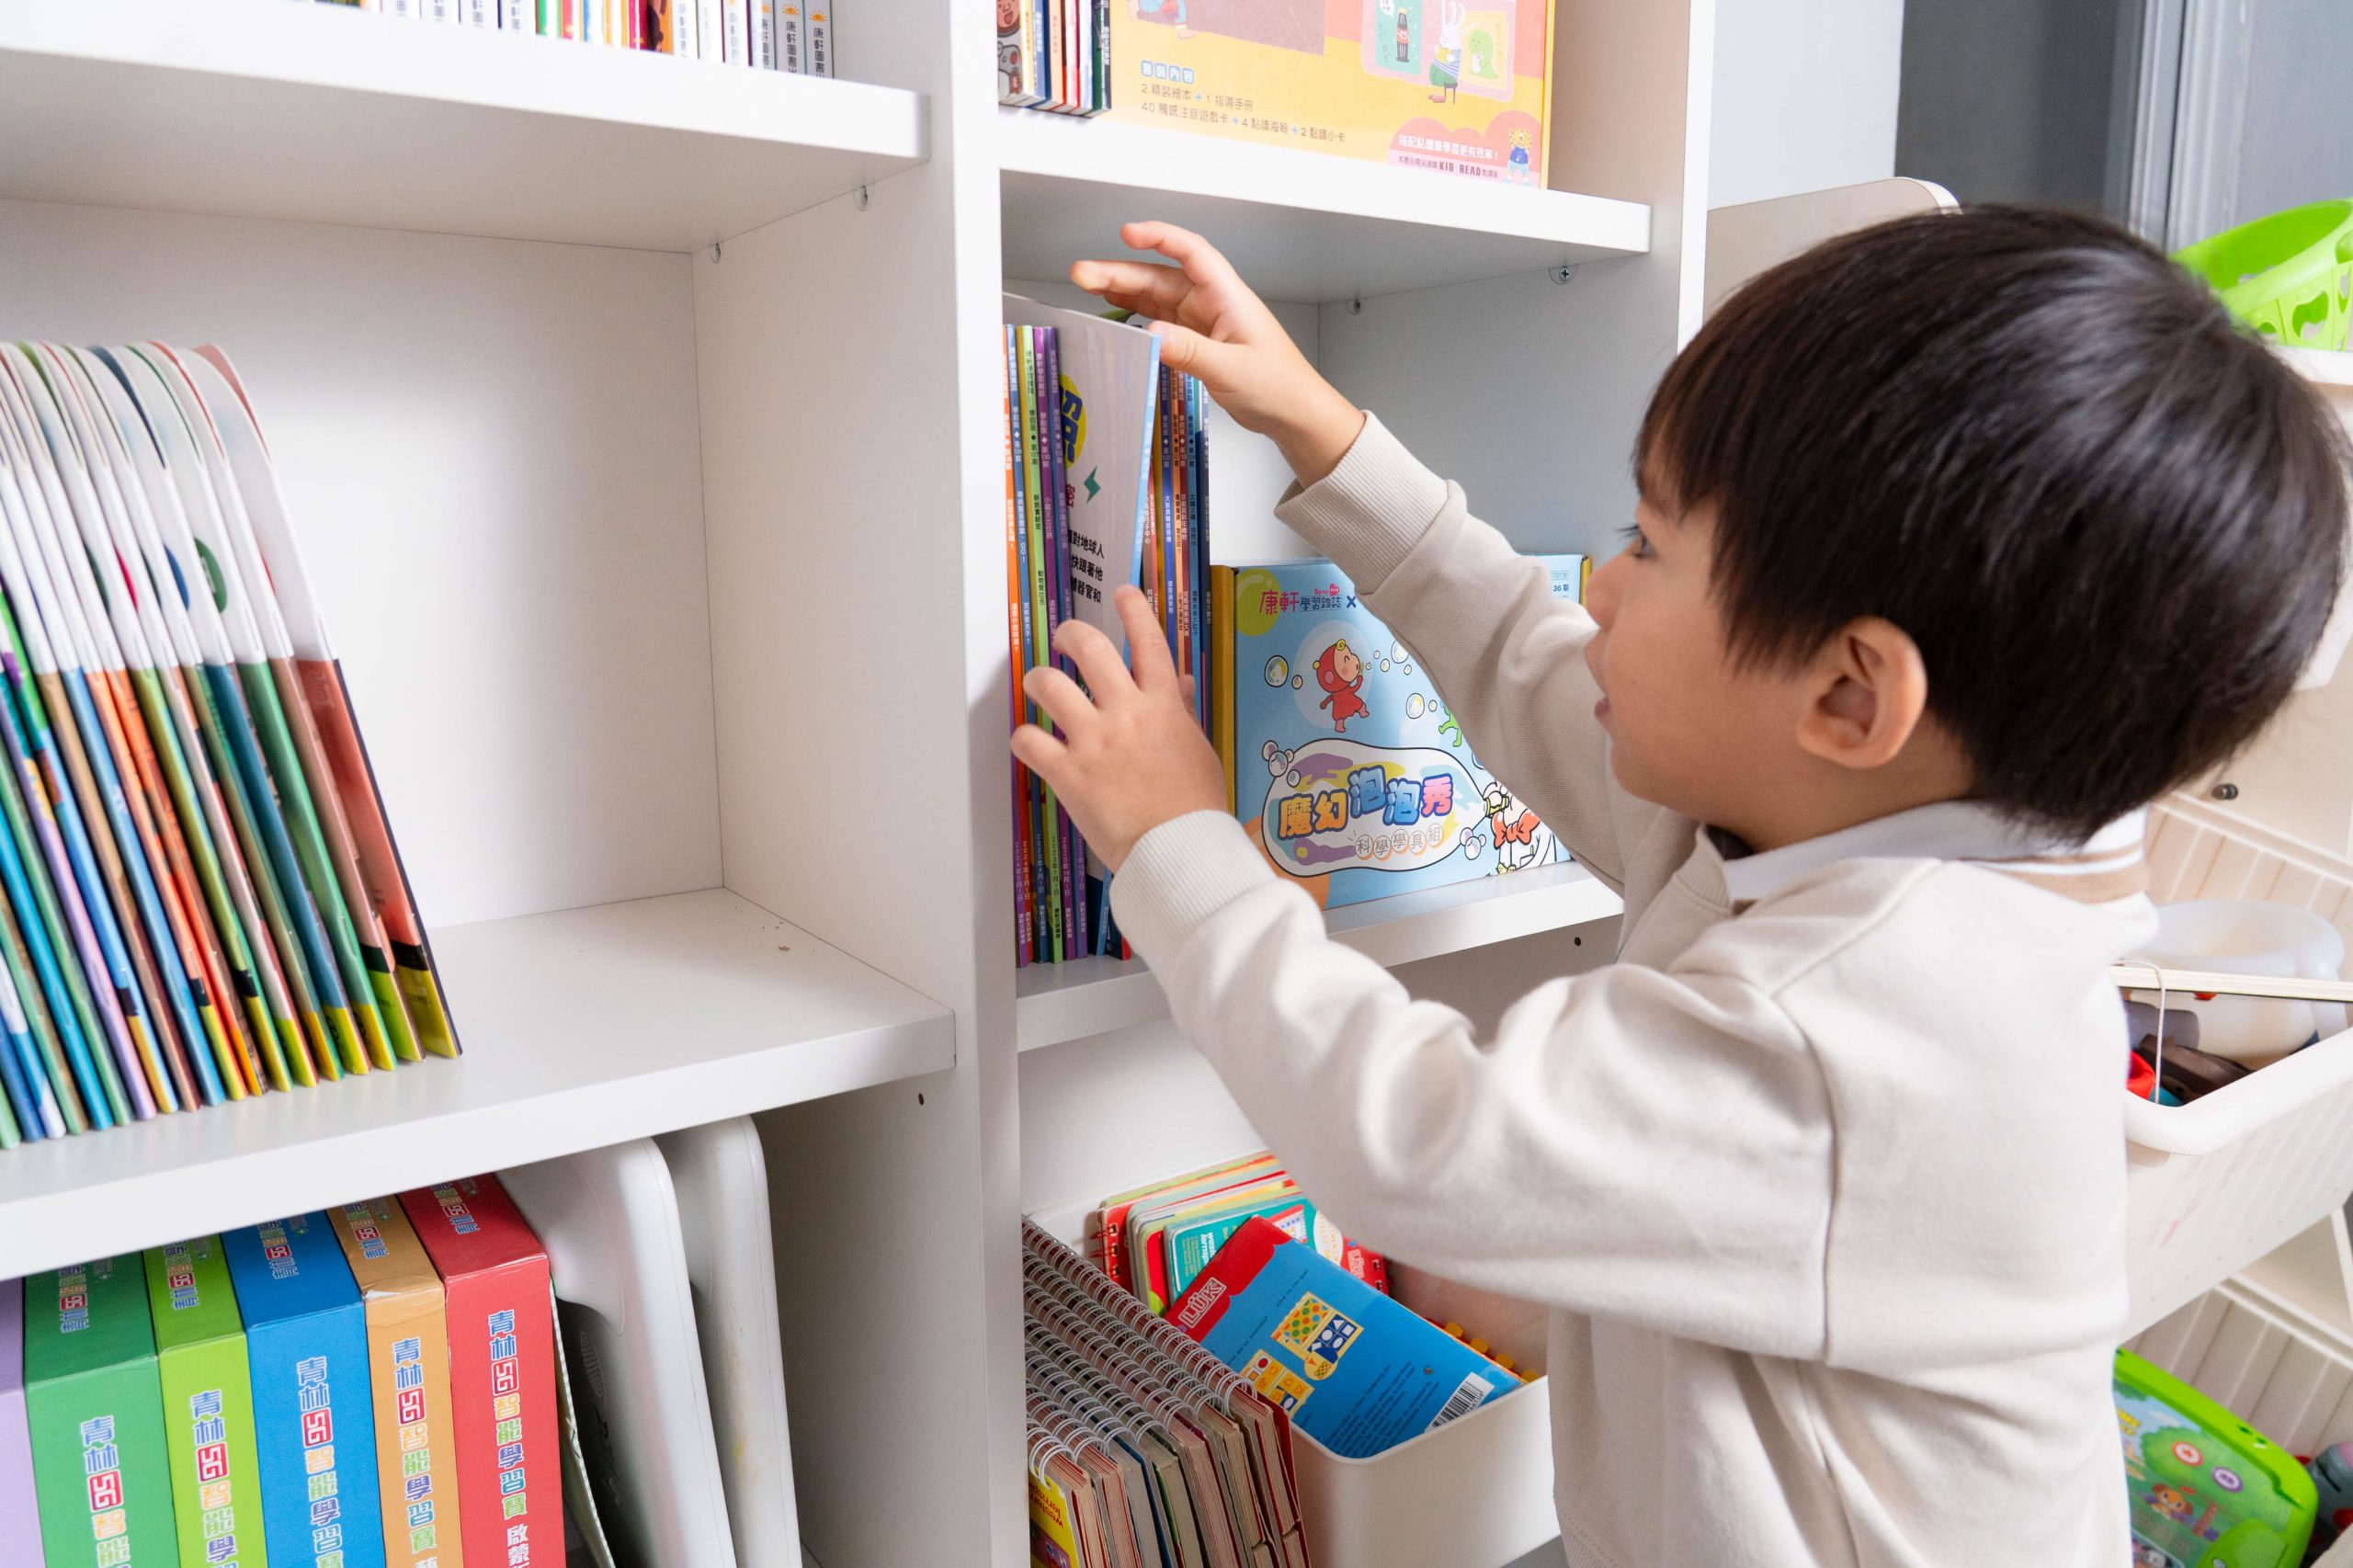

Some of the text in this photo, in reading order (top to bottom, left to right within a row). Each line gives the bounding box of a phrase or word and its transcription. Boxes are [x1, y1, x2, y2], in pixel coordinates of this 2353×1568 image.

[1141, 83, 1148, 94] 2
[1141, 102, 1155, 113] 40
[1242, 118, 1248, 128] 4
[1301, 127, 1307, 137] 2
[1459, 164, 1481, 177] READ
[1276, 765, 1454, 841] 魔幻泡泡秀
[1177, 1277, 1227, 1326] LÜK
[392, 1337, 437, 1554] 青林5G智能學習寶
[487, 1309, 528, 1520] 青林5G智能學習寶
[80, 1415, 131, 1568] 青林5G智能
[190, 1389, 238, 1568] 青林5G智能學
